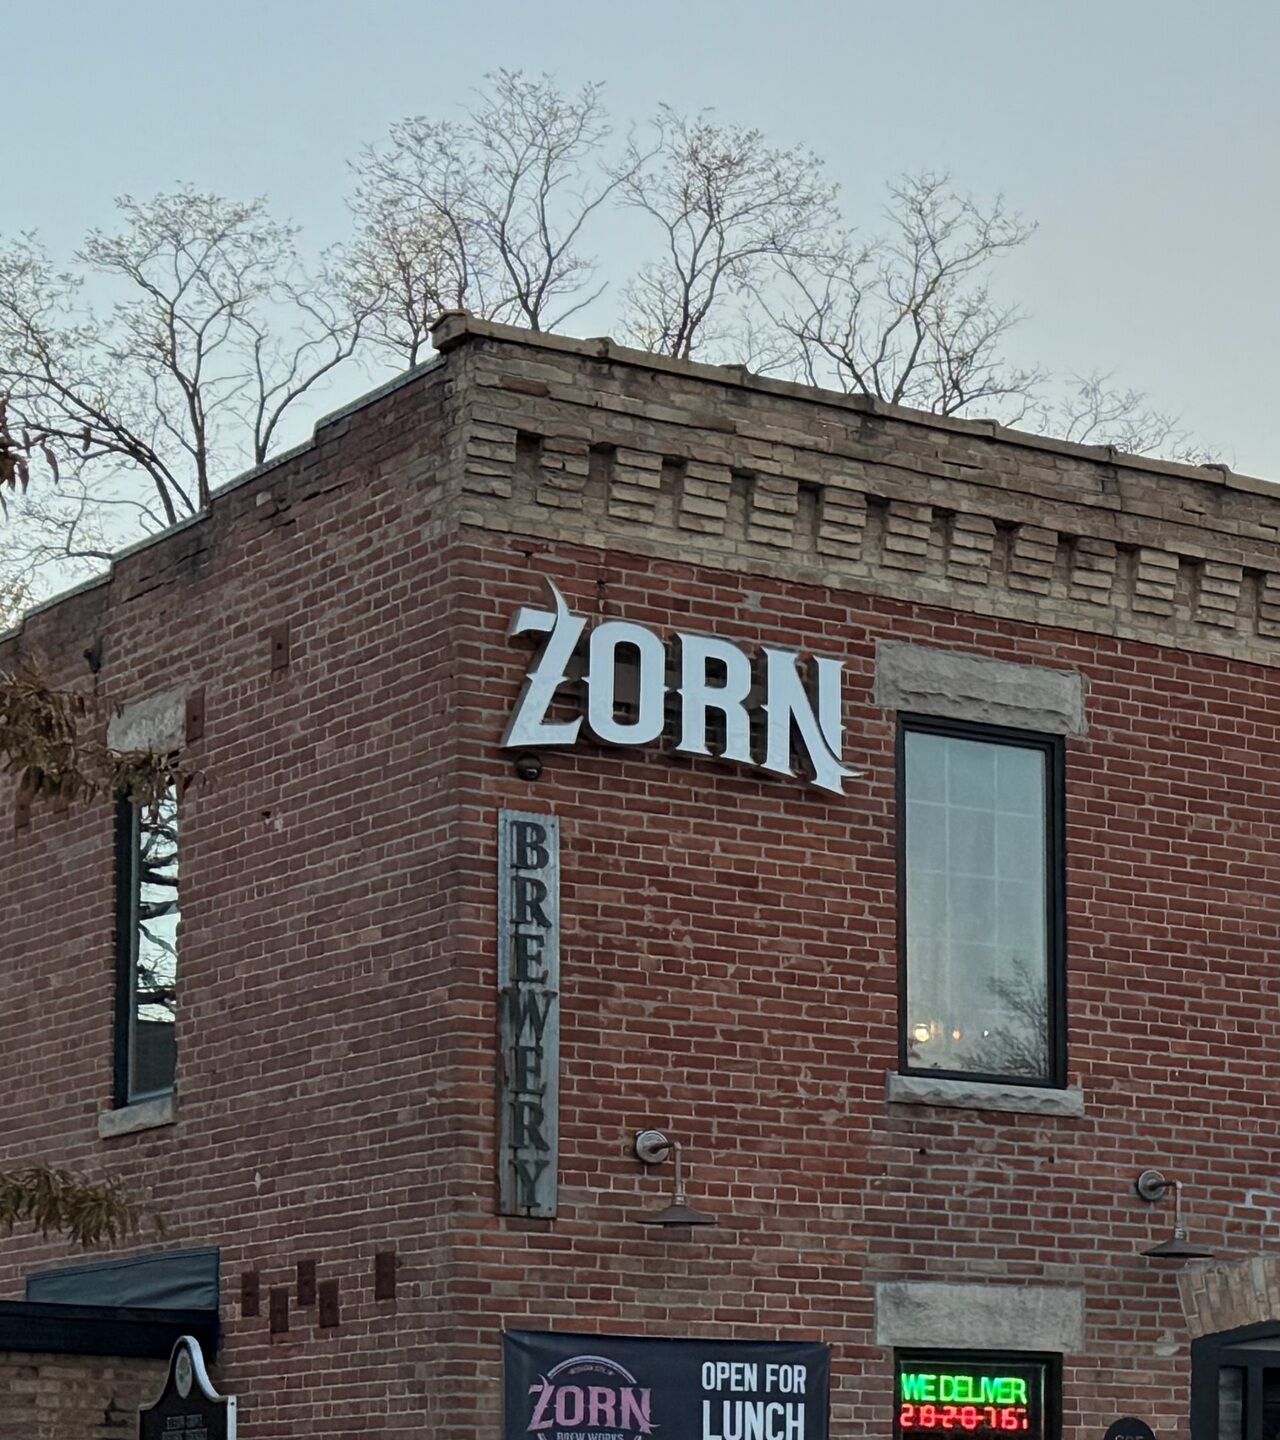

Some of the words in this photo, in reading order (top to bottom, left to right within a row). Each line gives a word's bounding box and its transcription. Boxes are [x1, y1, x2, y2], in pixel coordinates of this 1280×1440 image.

[505, 575, 868, 796] ZORN
[503, 820, 558, 1208] BREWERY
[527, 1374, 661, 1435] ZORN
[702, 1361, 758, 1392] OPEN
[765, 1363, 807, 1394] FOR
[901, 1373, 937, 1401] WE
